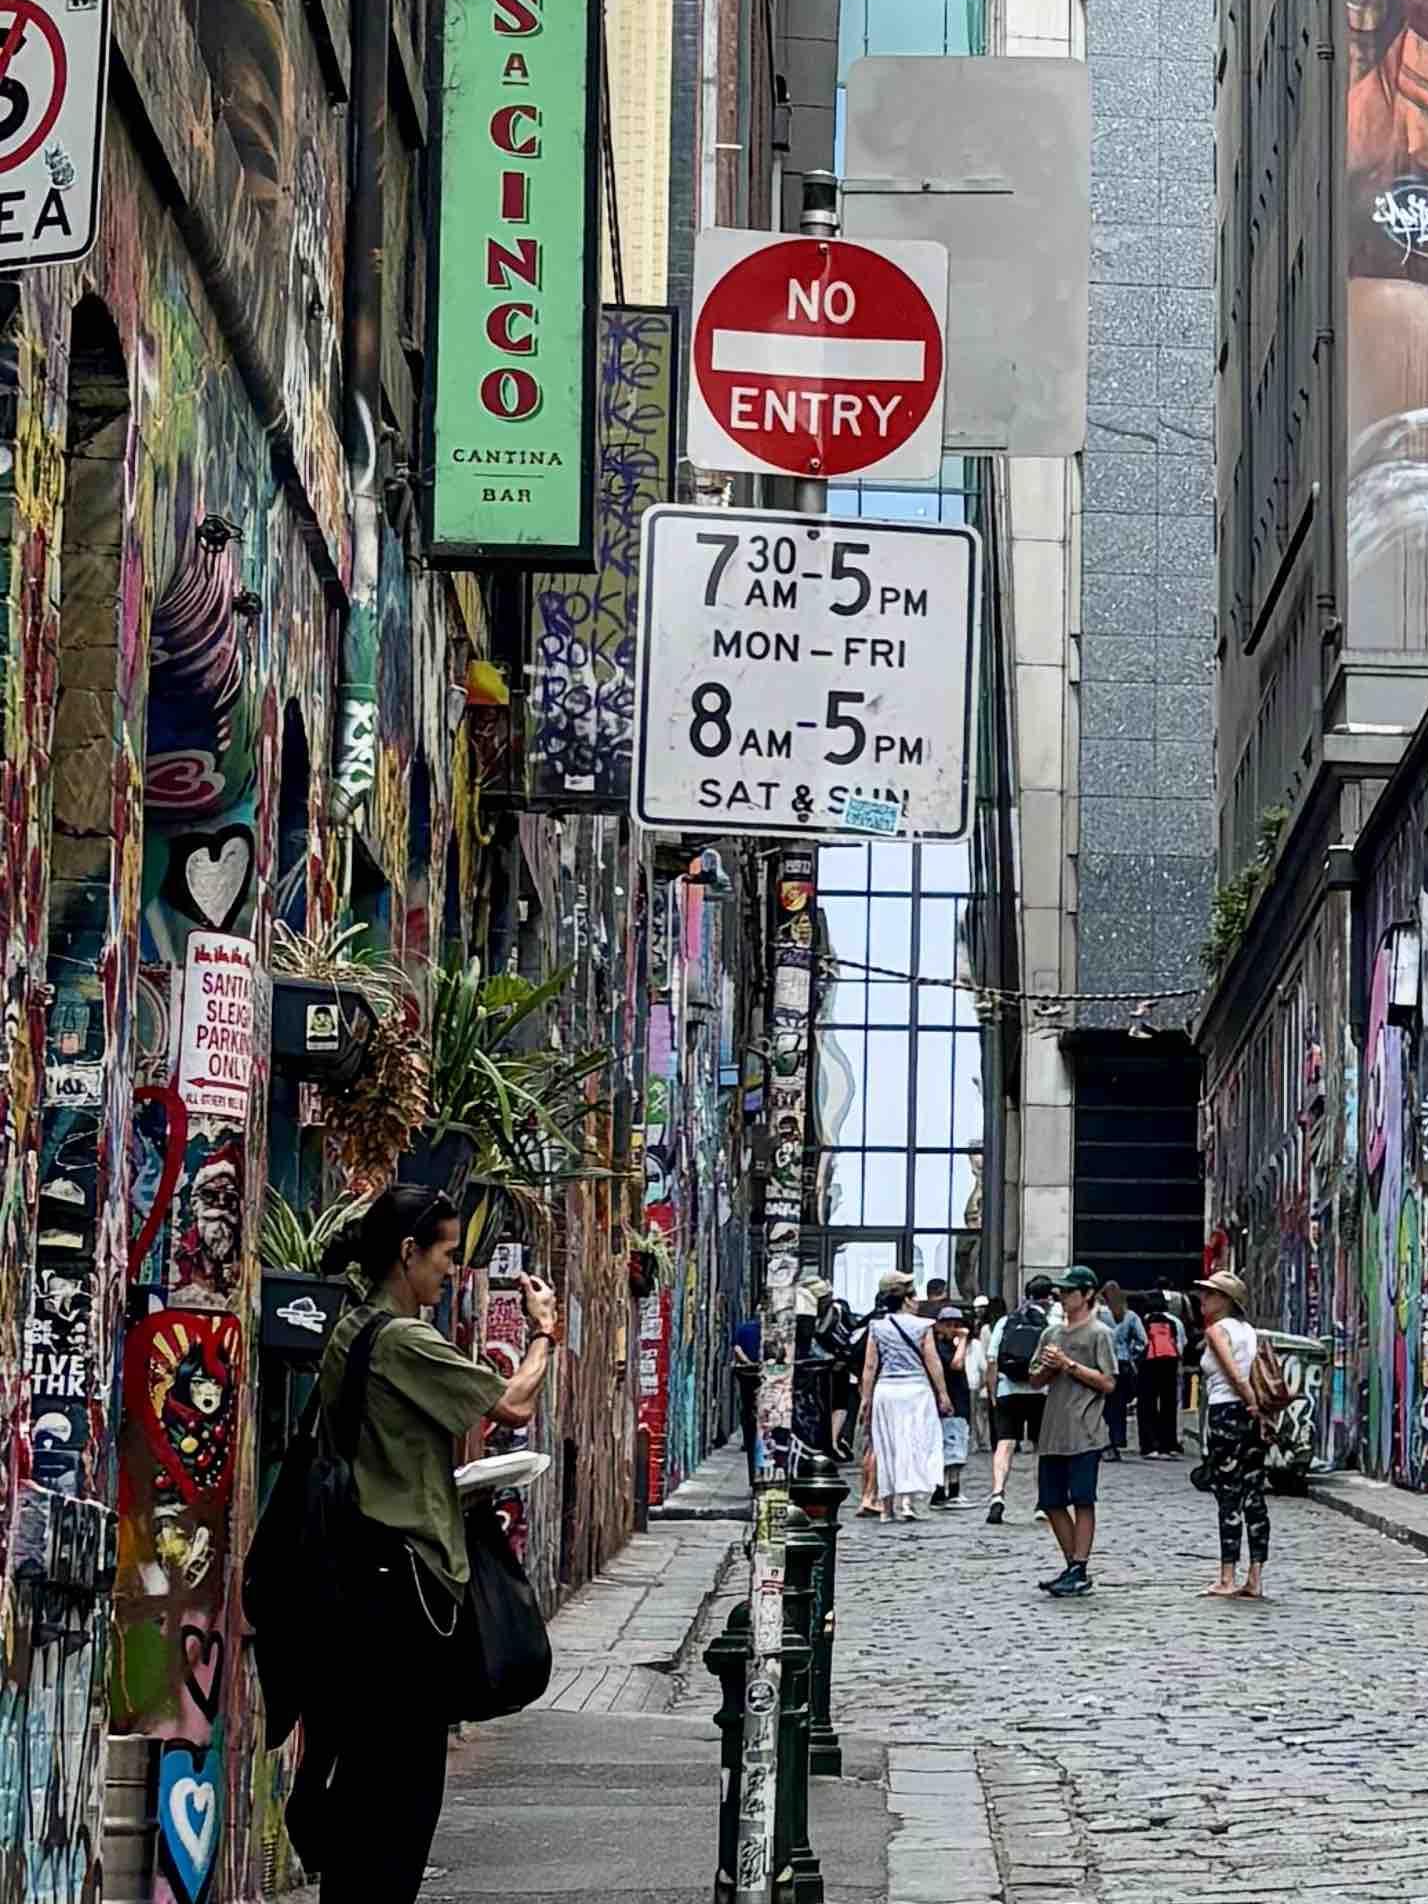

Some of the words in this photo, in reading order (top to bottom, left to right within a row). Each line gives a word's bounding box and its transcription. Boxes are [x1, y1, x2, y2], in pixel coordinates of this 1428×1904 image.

[478, 105, 544, 423] CINCO
[787, 278, 856, 325] NO
[730, 386, 903, 437] ENTRY
[452, 447, 563, 468] CANTINA
[481, 488, 532, 504] BAR
[880, 587, 927, 616] PM
[713, 629, 800, 662] MON
[844, 637, 906, 668] FRI
[875, 735, 923, 765] PM
[699, 779, 780, 810] SAT
[791, 785, 814, 814] &
